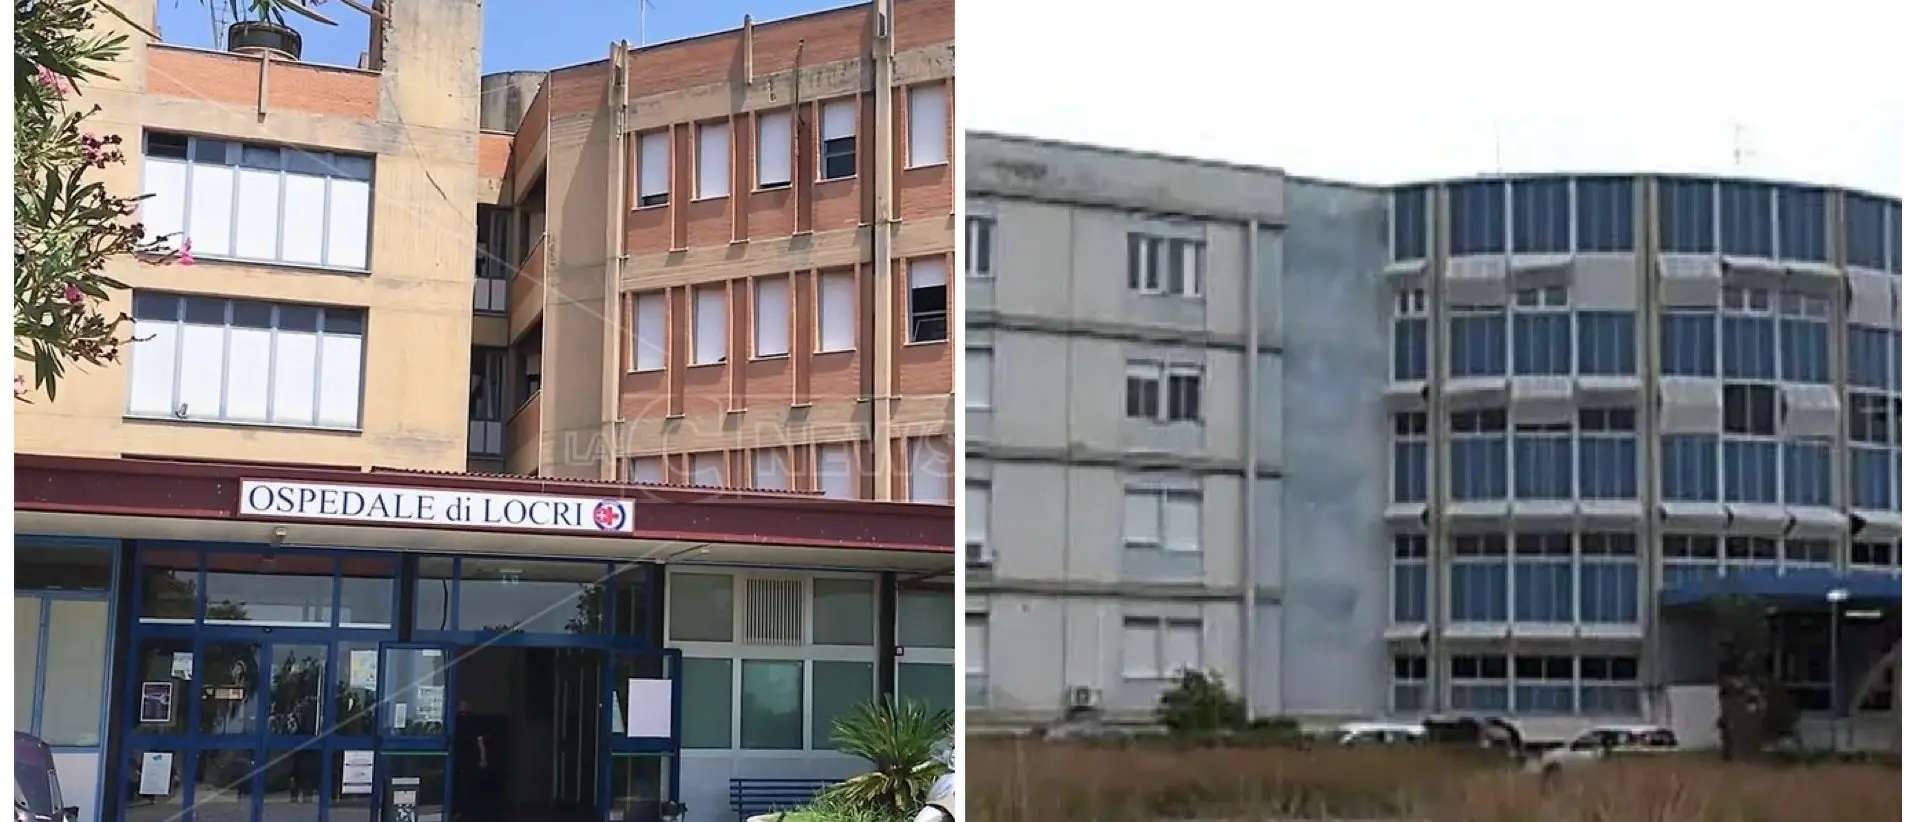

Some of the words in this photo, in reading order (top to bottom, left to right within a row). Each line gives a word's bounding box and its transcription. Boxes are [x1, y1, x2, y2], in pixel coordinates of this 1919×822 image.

[248, 484, 437, 522] OSPEDALE
[445, 496, 472, 523] di
[483, 497, 585, 527] LOCRI
